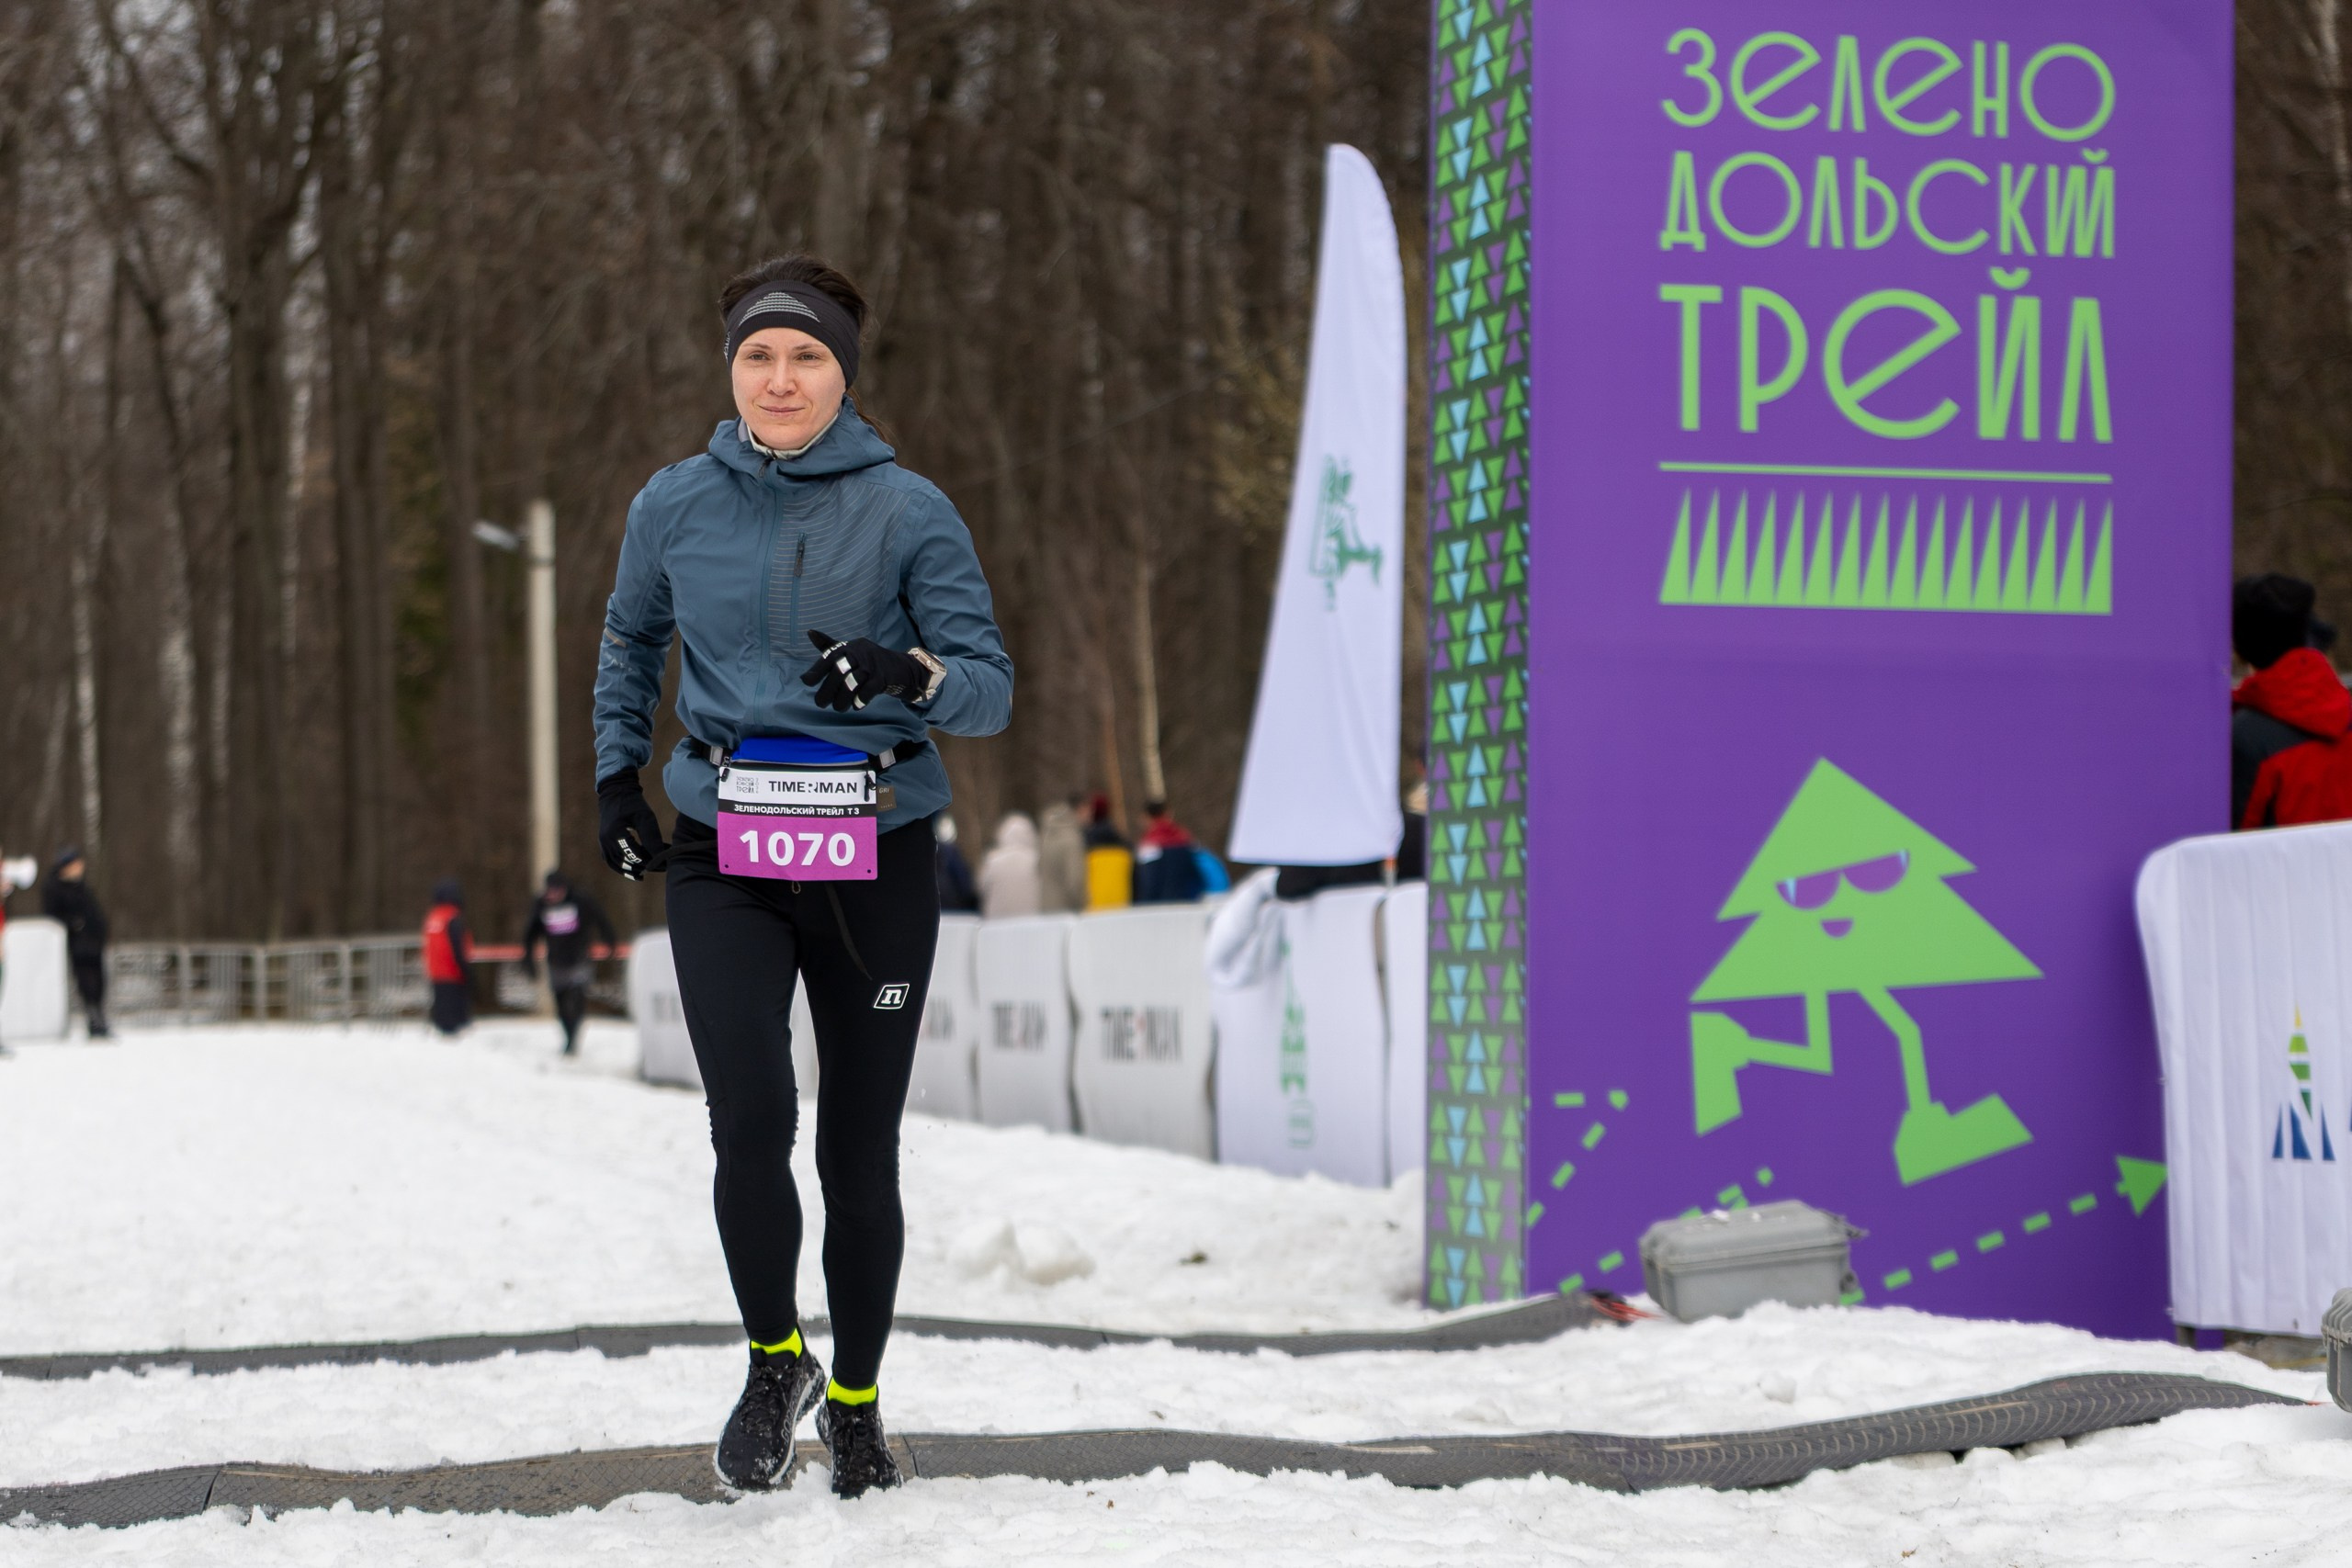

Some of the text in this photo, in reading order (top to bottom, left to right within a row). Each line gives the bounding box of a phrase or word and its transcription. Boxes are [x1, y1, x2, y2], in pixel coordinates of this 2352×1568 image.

[1659, 147, 2115, 258] ДОЛЬСКИЙ
[734, 804, 815, 816] ЗЕЛЕНОДОЛЬСКИЙ
[816, 807, 844, 816] ТРЕЙЛ
[740, 830, 855, 866] 1070
